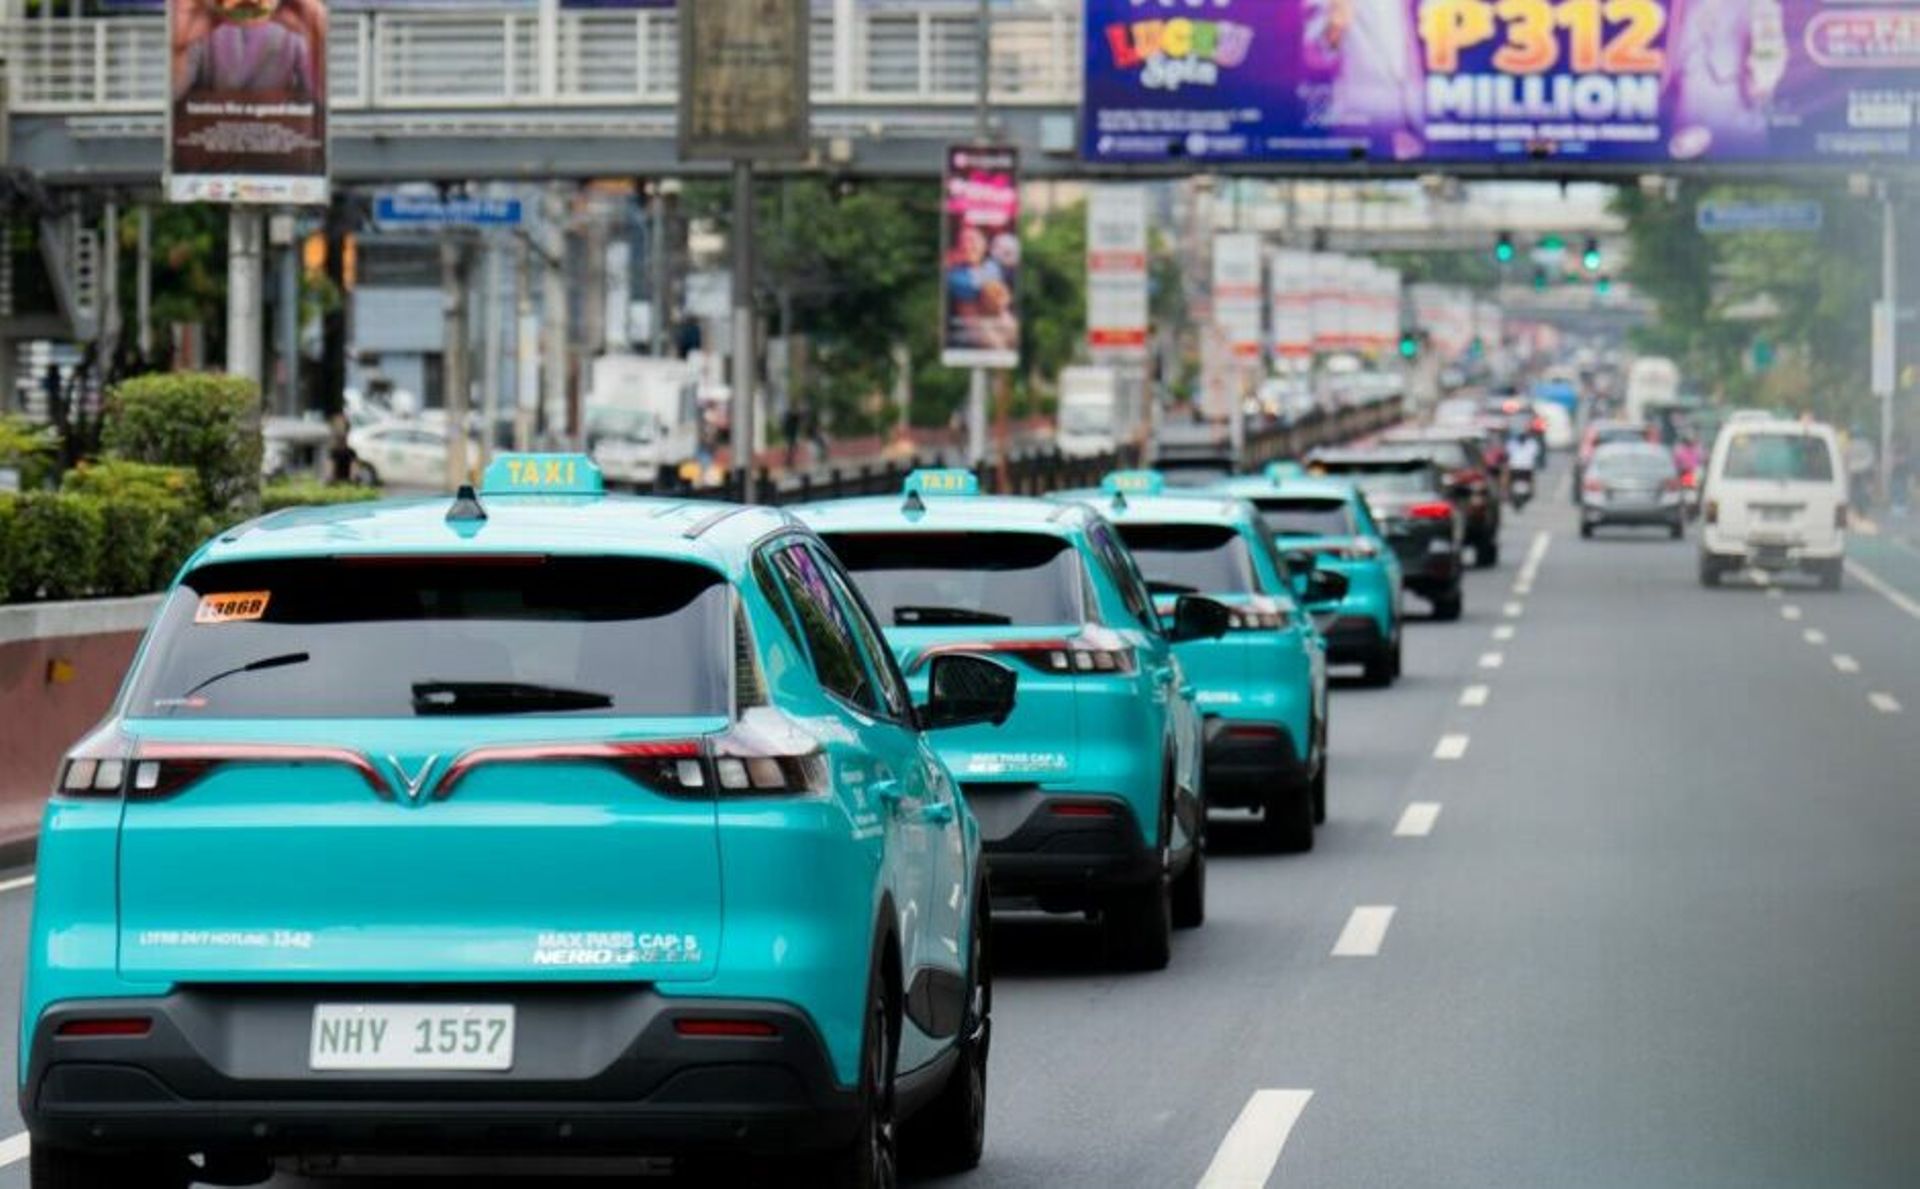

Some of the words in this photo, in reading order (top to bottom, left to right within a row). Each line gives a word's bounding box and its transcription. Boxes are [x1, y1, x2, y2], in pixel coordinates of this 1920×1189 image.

[1426, 74, 1660, 119] MILLION
[508, 459, 576, 485] TAXI
[922, 474, 966, 490] TAXI
[538, 931, 584, 949] MAX
[586, 931, 636, 950] PASS
[318, 1018, 389, 1054] NHY
[413, 1018, 507, 1054] 1557
